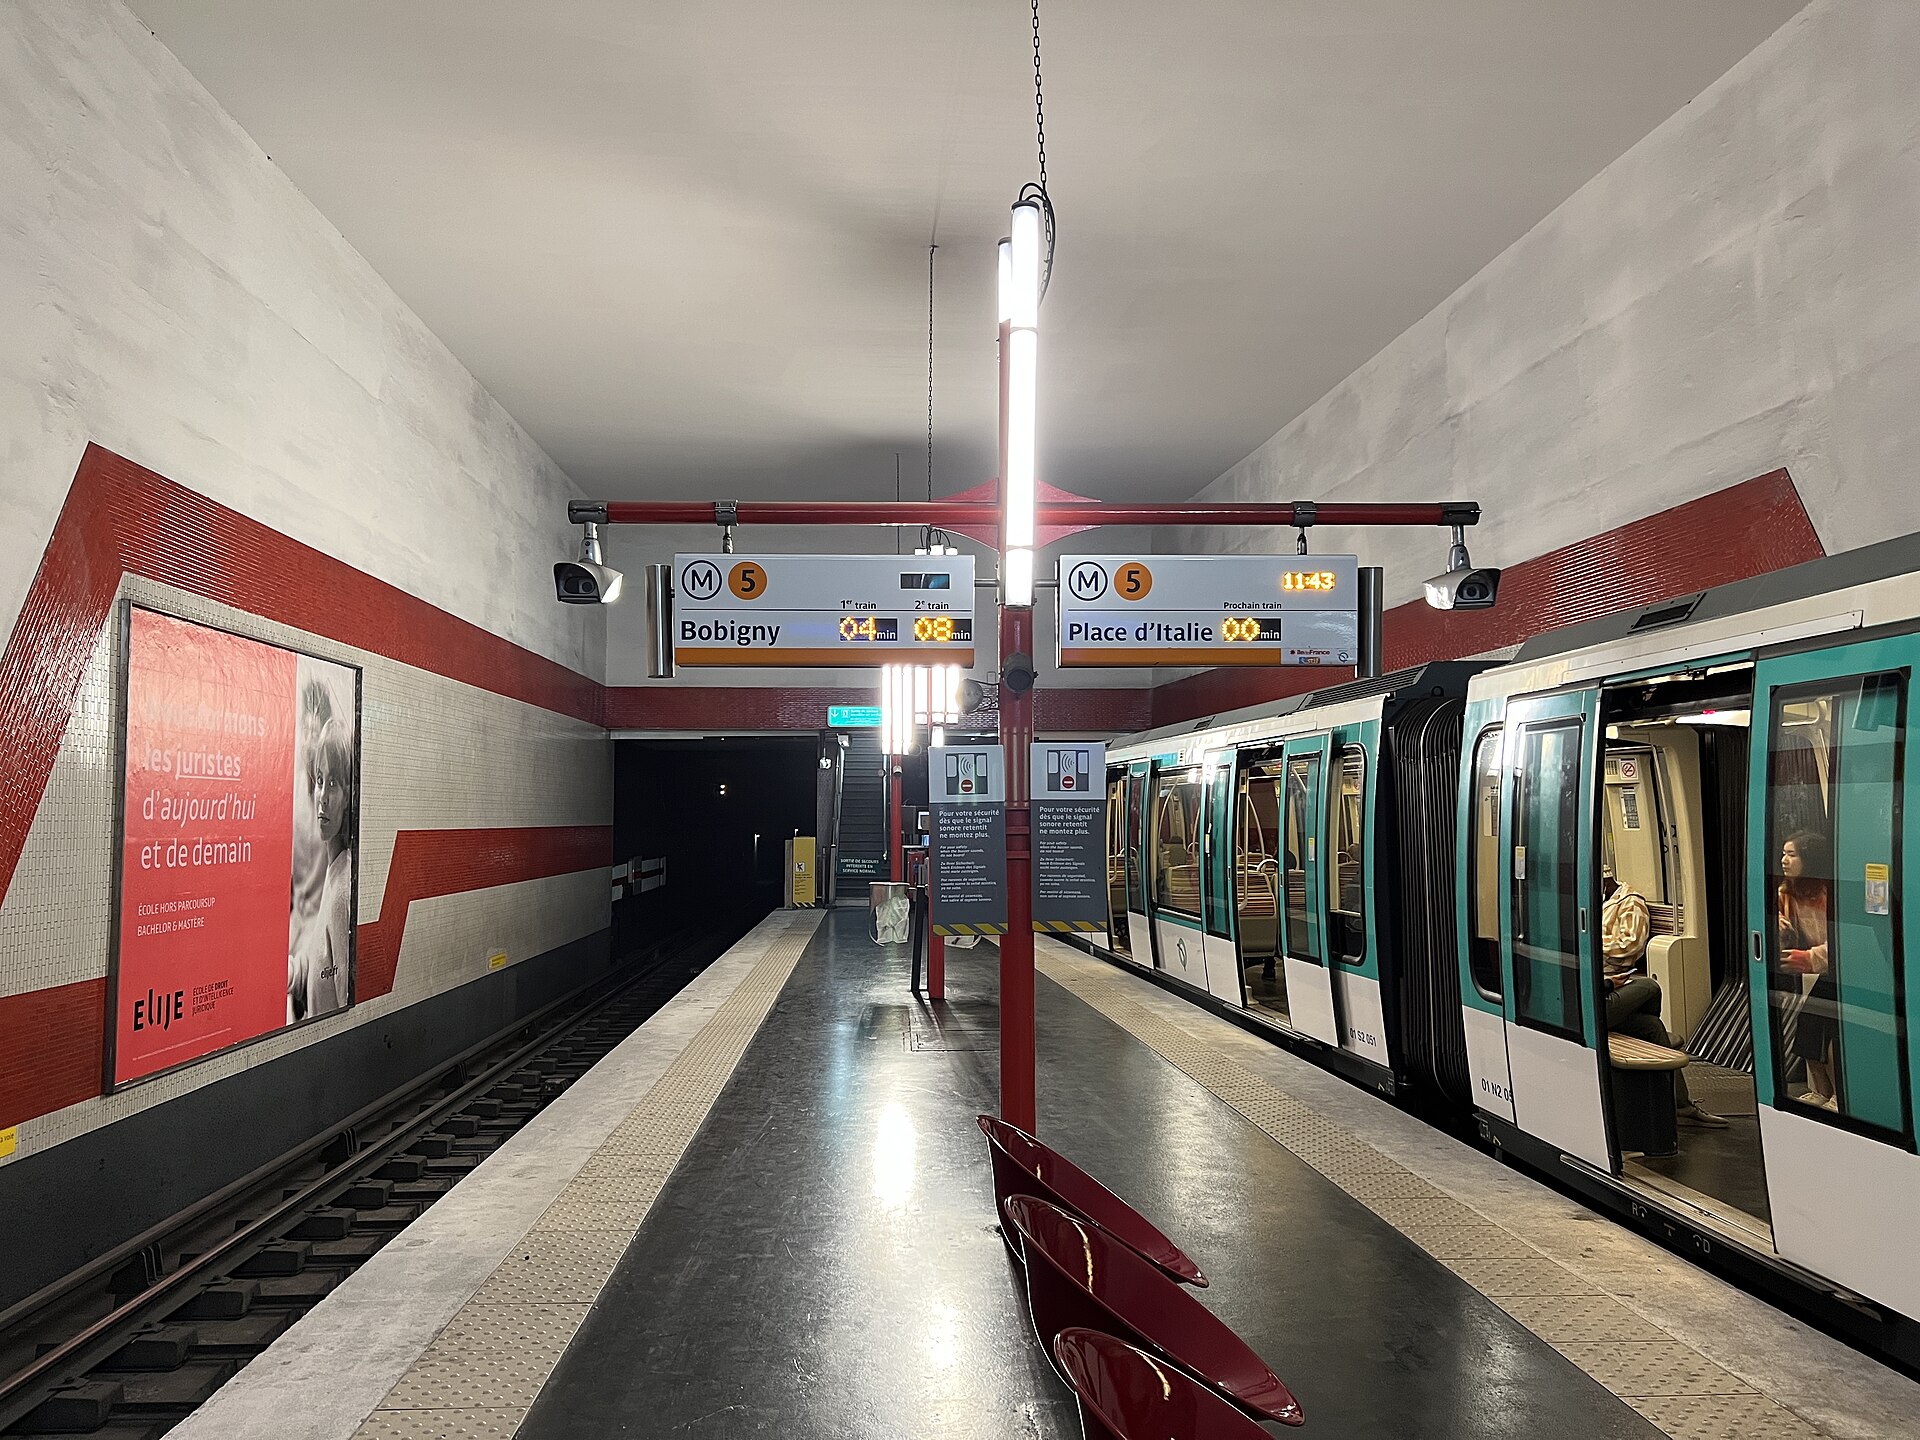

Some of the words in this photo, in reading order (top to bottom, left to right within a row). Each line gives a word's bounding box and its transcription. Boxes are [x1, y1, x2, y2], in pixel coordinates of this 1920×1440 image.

[691, 569, 713, 591] M
[740, 569, 755, 592] 5
[1077, 570, 1099, 592] M
[1126, 570, 1141, 593] 5
[1283, 572, 1335, 590] 11:43
[681, 620, 780, 646] Bobigny
[839, 616, 876, 641] 04
[876, 629, 896, 640] min
[914, 616, 952, 641] 08
[951, 629, 971, 640] min
[1069, 623, 1127, 641] Place
[1135, 622, 1213, 641] d'Italie
[1221, 617, 1260, 641] 00
[1260, 630, 1280, 639] min
[175, 746, 242, 780] juristes
[142, 789, 257, 828] d'aujourd'hui
[141, 841, 162, 869] et
[166, 838, 188, 868] de
[192, 836, 251, 866] demain
[160, 901, 177, 913] HORS
[177, 897, 216, 911] PARCOURSUP
[137, 922, 172, 937] BACHELOR
[172, 920, 178, 932] &
[1350, 1028, 1356, 1039] 01
[1357, 1031, 1366, 1042] S2
[1366, 1034, 1377, 1047] 051
[1482, 1078, 1490, 1092] 01
[1491, 1082, 1502, 1098] N2
